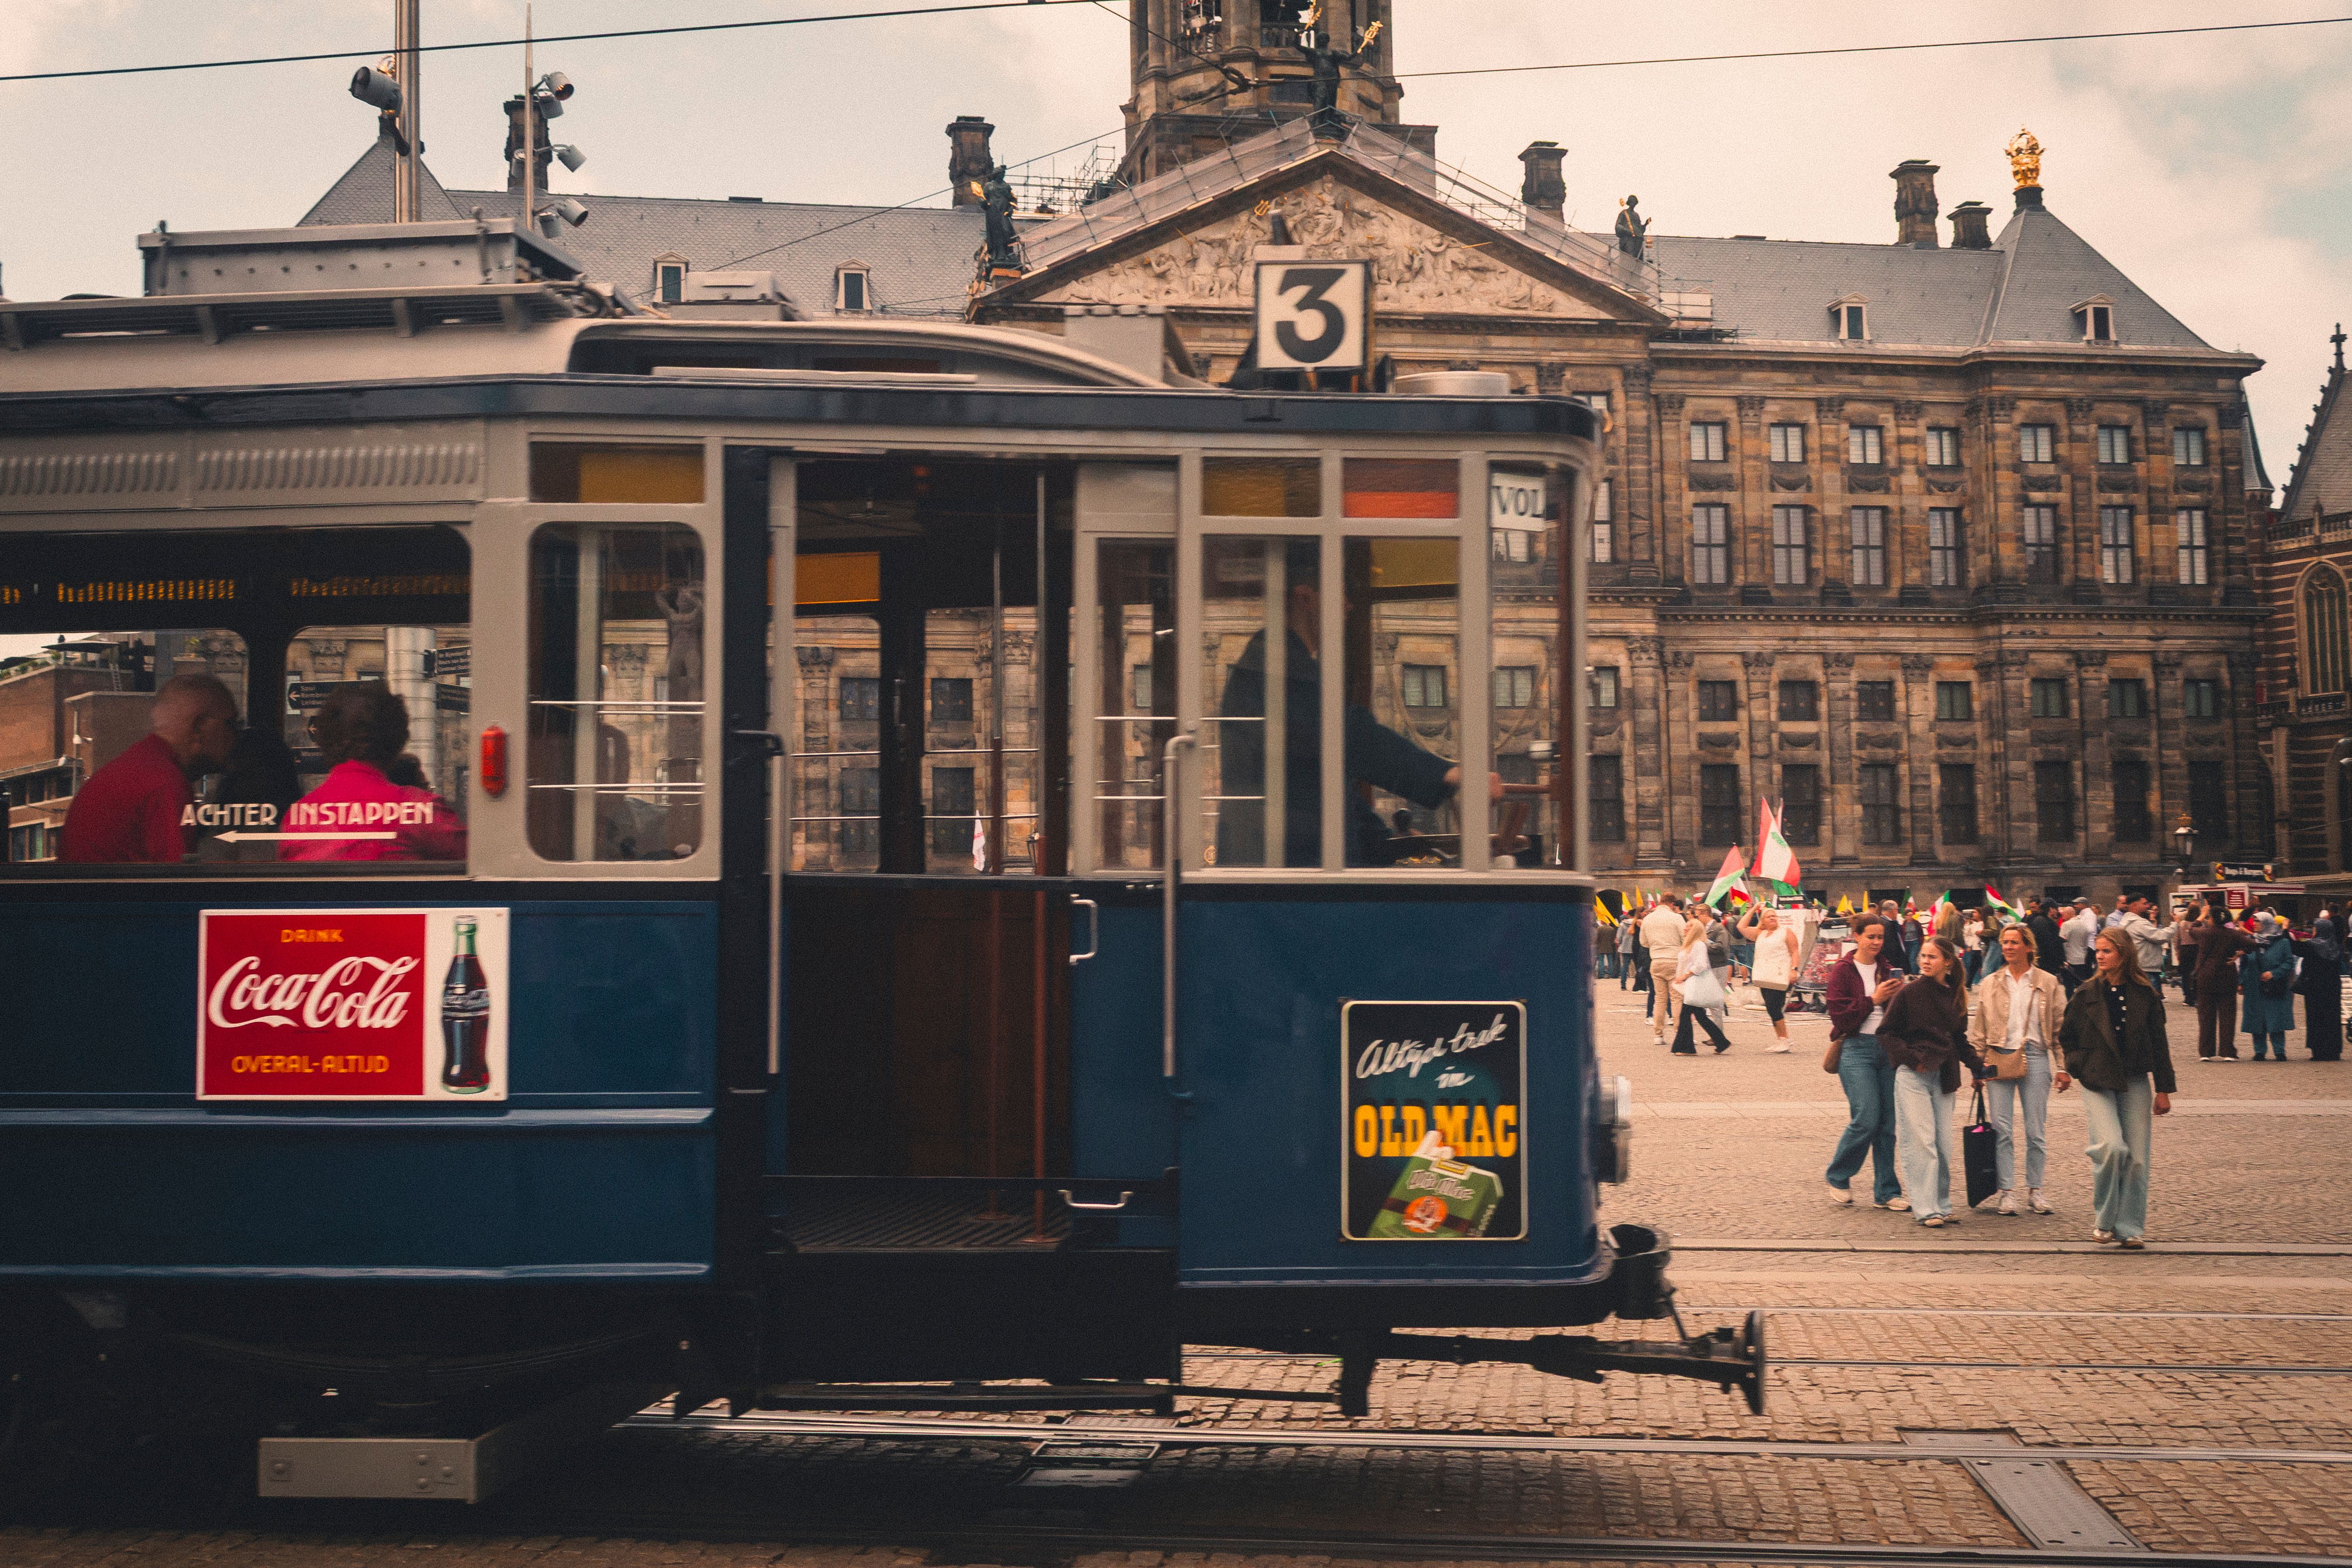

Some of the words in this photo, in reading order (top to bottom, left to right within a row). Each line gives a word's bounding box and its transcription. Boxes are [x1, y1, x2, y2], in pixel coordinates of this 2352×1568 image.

[1275, 268, 1347, 363] 3
[1490, 486, 1545, 518] VOL
[180, 804, 277, 826] ACHTER
[290, 802, 434, 825] INSTAPPEN
[281, 929, 344, 942] DRINK
[208, 956, 420, 1028] Coca-Cola
[1435, 1066, 1475, 1089] in
[1354, 1105, 1427, 1157] OLD
[1432, 1105, 1517, 1157] MAC
